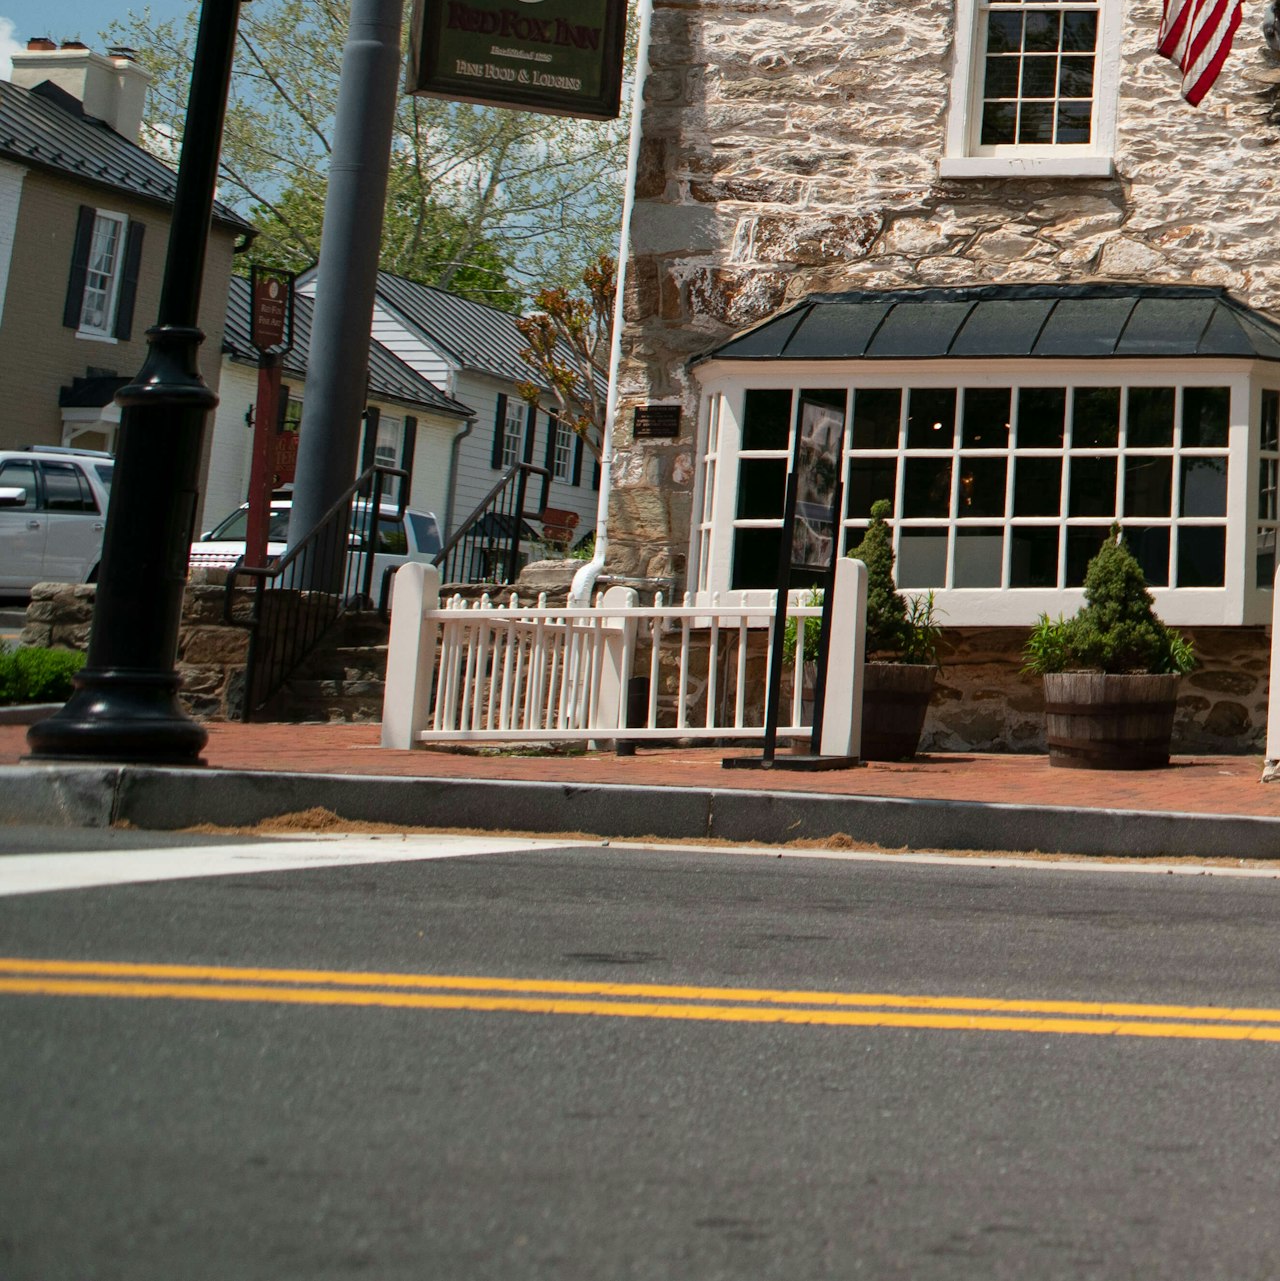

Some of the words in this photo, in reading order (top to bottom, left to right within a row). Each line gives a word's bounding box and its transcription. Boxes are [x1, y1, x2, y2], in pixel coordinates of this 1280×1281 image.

[455, 59, 484, 78] FINE
[484, 63, 516, 81] FOOD
[517, 69, 529, 84] &
